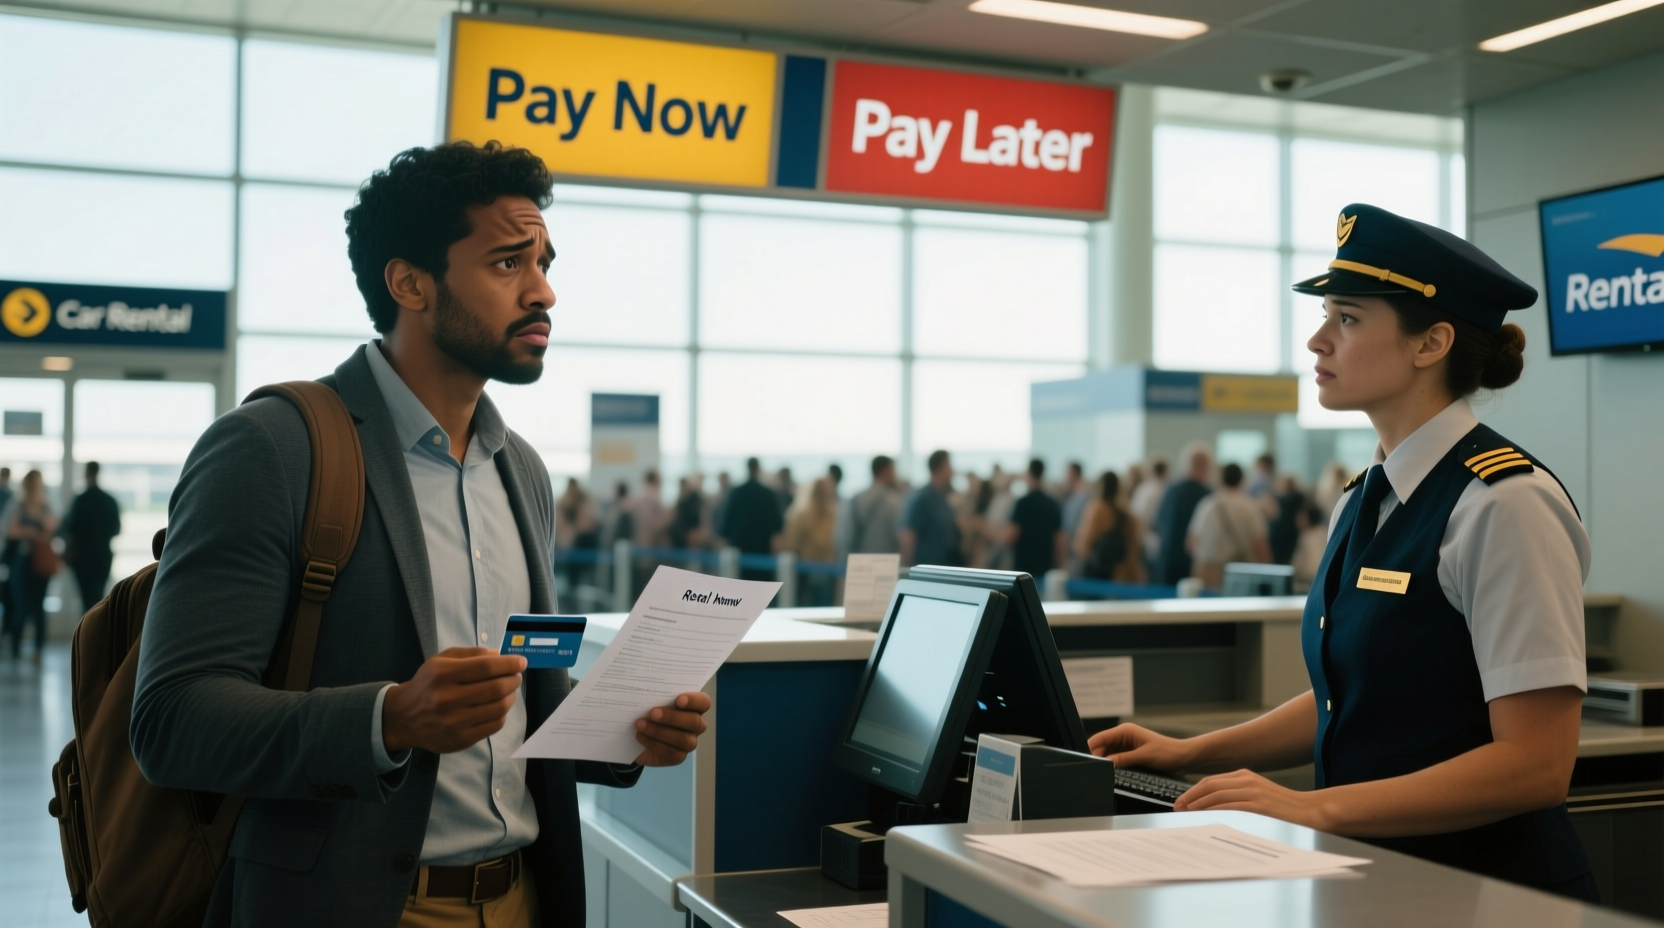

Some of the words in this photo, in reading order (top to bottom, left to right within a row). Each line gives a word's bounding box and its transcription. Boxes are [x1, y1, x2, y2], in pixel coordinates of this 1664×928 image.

[486, 67, 596, 141] Pay
[613, 80, 747, 141] Now
[851, 99, 953, 174] Pay
[960, 109, 1094, 173] Later
[56, 299, 104, 330] Car
[105, 301, 193, 335] Rental
